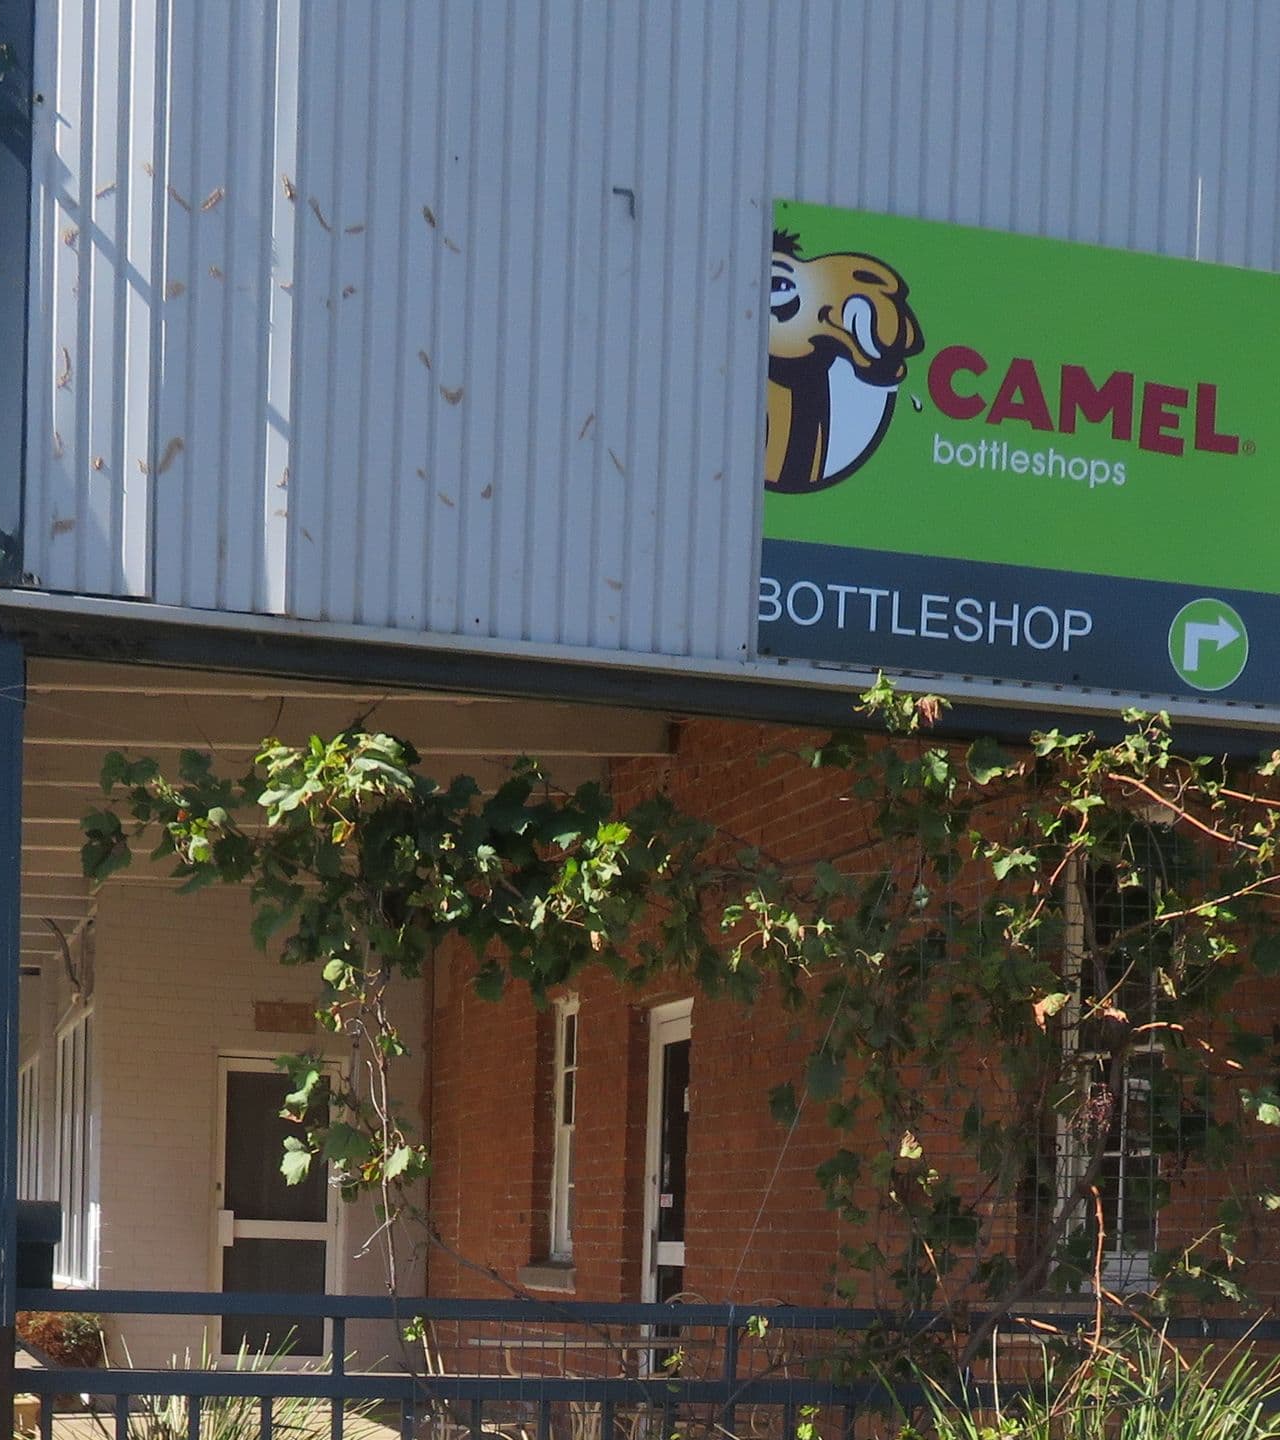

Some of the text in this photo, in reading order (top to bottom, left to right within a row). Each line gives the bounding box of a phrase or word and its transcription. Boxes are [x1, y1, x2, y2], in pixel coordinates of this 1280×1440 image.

[927, 345, 1239, 457] CAMEL
[933, 433, 1126, 488] bottleshops
[758, 577, 1093, 652] BOTTLESHOP
